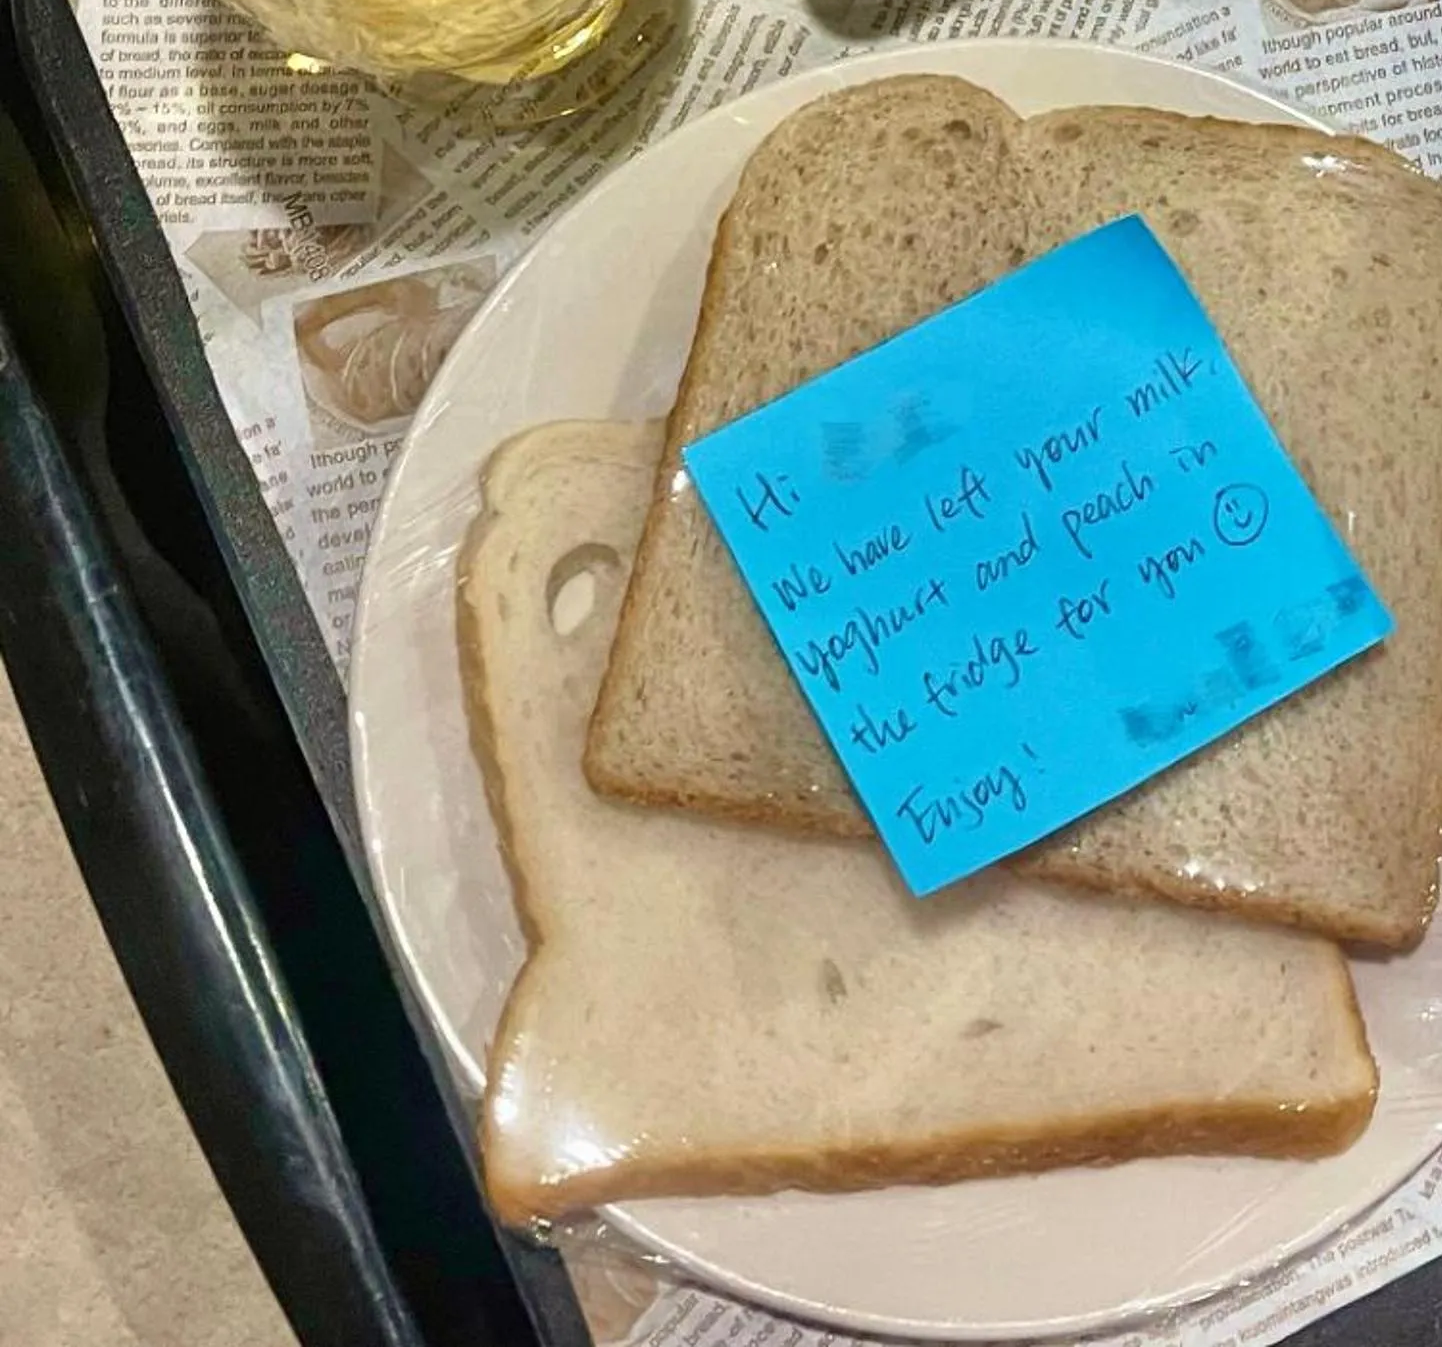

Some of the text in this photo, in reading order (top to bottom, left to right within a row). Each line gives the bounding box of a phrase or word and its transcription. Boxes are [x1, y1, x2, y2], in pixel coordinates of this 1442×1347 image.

[102, 13, 140, 26] such
[166, 12, 221, 25] several
[1325, 17, 1384, 42] popular
[1388, 4, 1442, 28] around
[100, 30, 158, 45] formula
[1258, 59, 1302, 80] world
[1304, 55, 1322, 71] to
[1325, 48, 1351, 66] eat
[1408, 28, 1439, 50] but,
[118, 67, 181, 80] medium
[1294, 66, 1387, 101] perspective
[1392, 60, 1408, 76] of
[219, 100, 319, 117] consumption
[323, 101, 340, 117] by
[157, 120, 188, 132] and
[250, 117, 280, 131] milk
[291, 117, 320, 130] and
[330, 116, 369, 130] other
[1382, 111, 1403, 127] for
[190, 137, 265, 154] Compared
[269, 136, 298, 150] with
[301, 136, 324, 149] the
[209, 156, 278, 168] structure
[299, 155, 338, 166] more
[195, 173, 261, 186] excellent
[175, 192, 217, 205] bread
[307, 470, 377, 499] world to
[736, 472, 801, 532] Hi
[772, 563, 832, 612] We
[832, 525, 914, 575] have
[924, 465, 991, 533] left
[1013, 406, 1102, 492] your
[312, 506, 341, 524] the
[796, 440, 1218, 693] yoghurt and peach in
[851, 537, 1206, 754] the fridge for you
